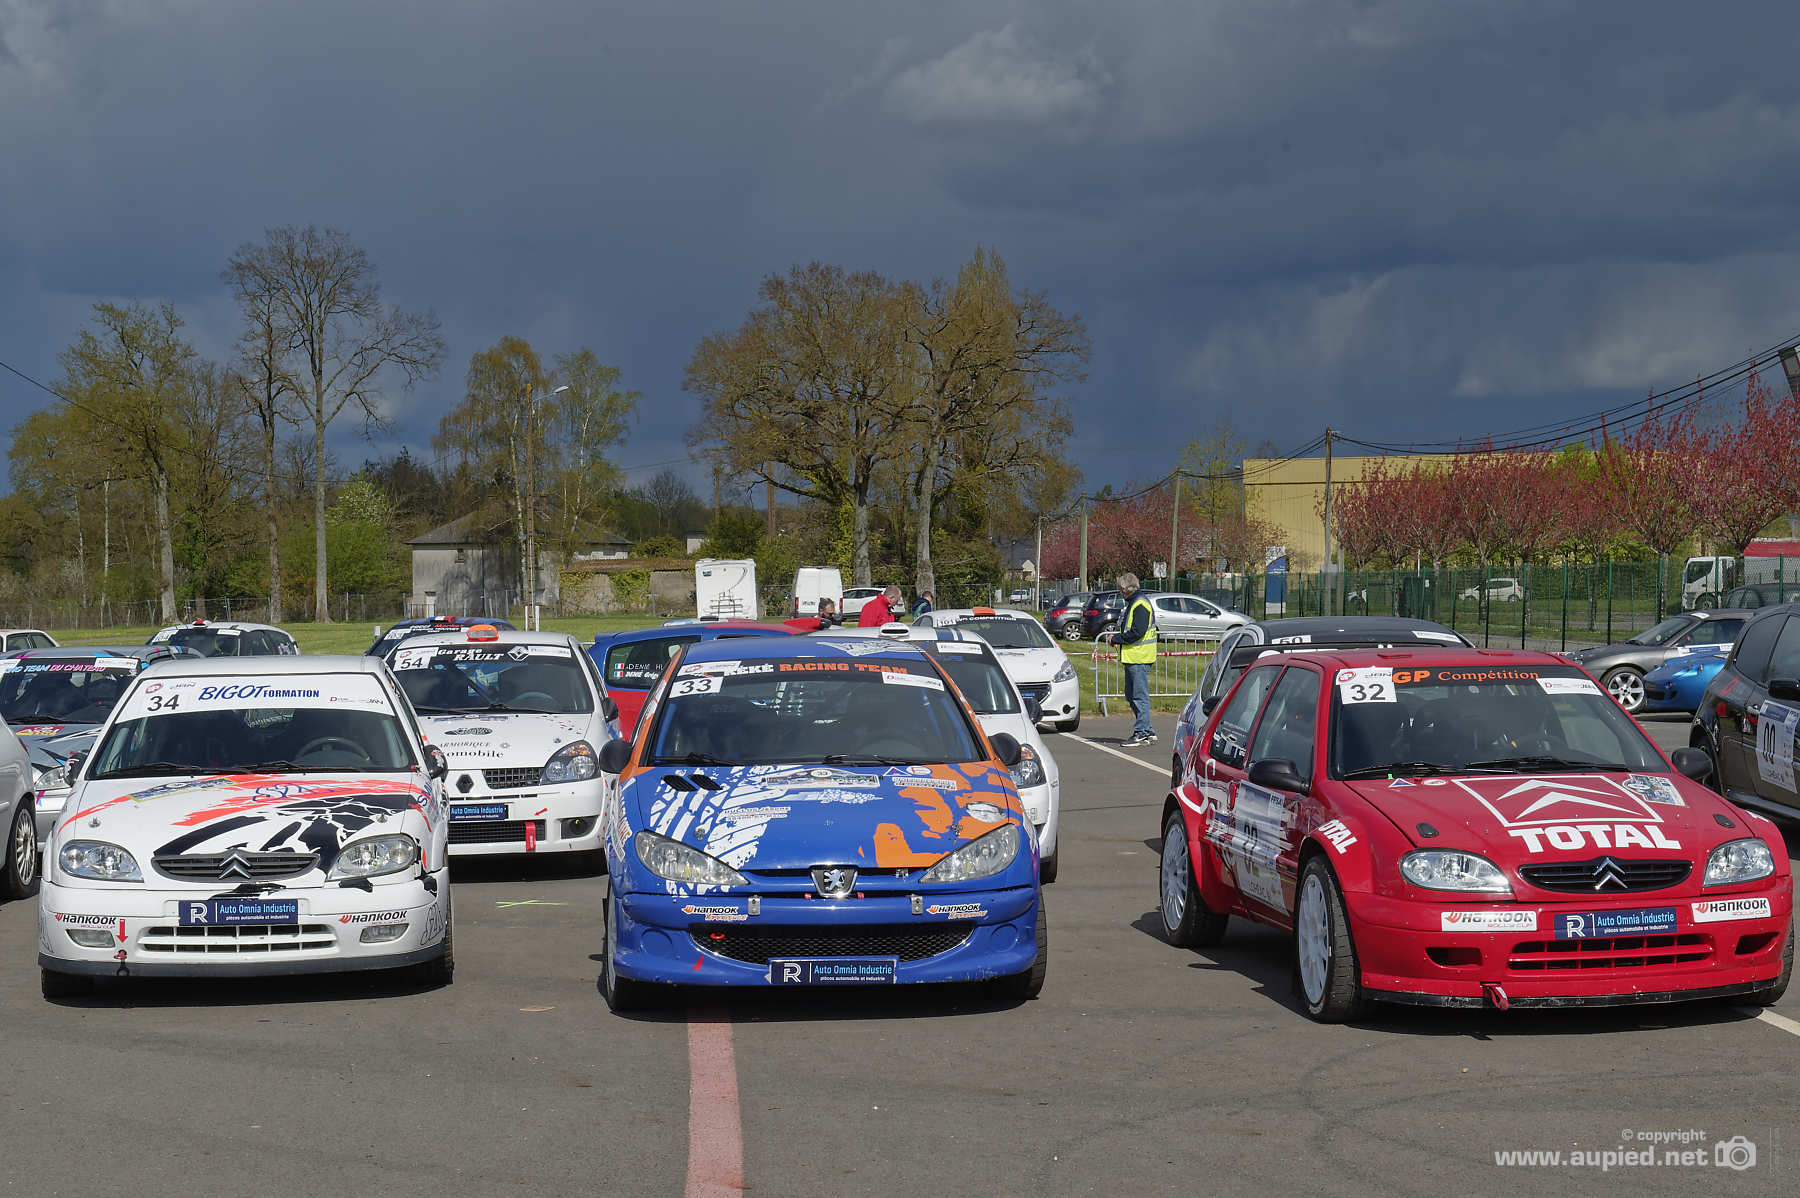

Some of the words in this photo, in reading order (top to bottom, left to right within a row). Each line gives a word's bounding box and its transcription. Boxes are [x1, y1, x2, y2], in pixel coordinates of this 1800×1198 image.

[400, 657, 423, 669] 54
[454, 653, 504, 662] RAULT
[779, 663, 849, 672] RACING
[854, 663, 908, 674] TEAM
[1392, 670, 1431, 684] GP
[1438, 669, 1540, 682] Compétition
[198, 685, 272, 701] BIGOT
[263, 688, 320, 699] FORMATION
[679, 678, 712, 694] 33
[1350, 683, 1386, 702] 32
[147, 694, 180, 712] 34
[446, 750, 504, 758] omobile
[451, 807, 463, 815] Auto
[480, 806, 503, 814] Industrie
[1318, 819, 1358, 855] OTAL
[1507, 824, 1682, 854] TOTAL
[220, 904, 237, 914] Auto
[238, 903, 262, 914] Omnia
[263, 903, 296, 913] Industrie
[1597, 916, 1615, 927] Auto
[1616, 914, 1640, 925] Omnia
[1641, 912, 1675, 923] Industrie
[814, 965, 832, 974] Auto
[833, 965, 857, 974] Omnia
[859, 964, 893, 974] Industrie
